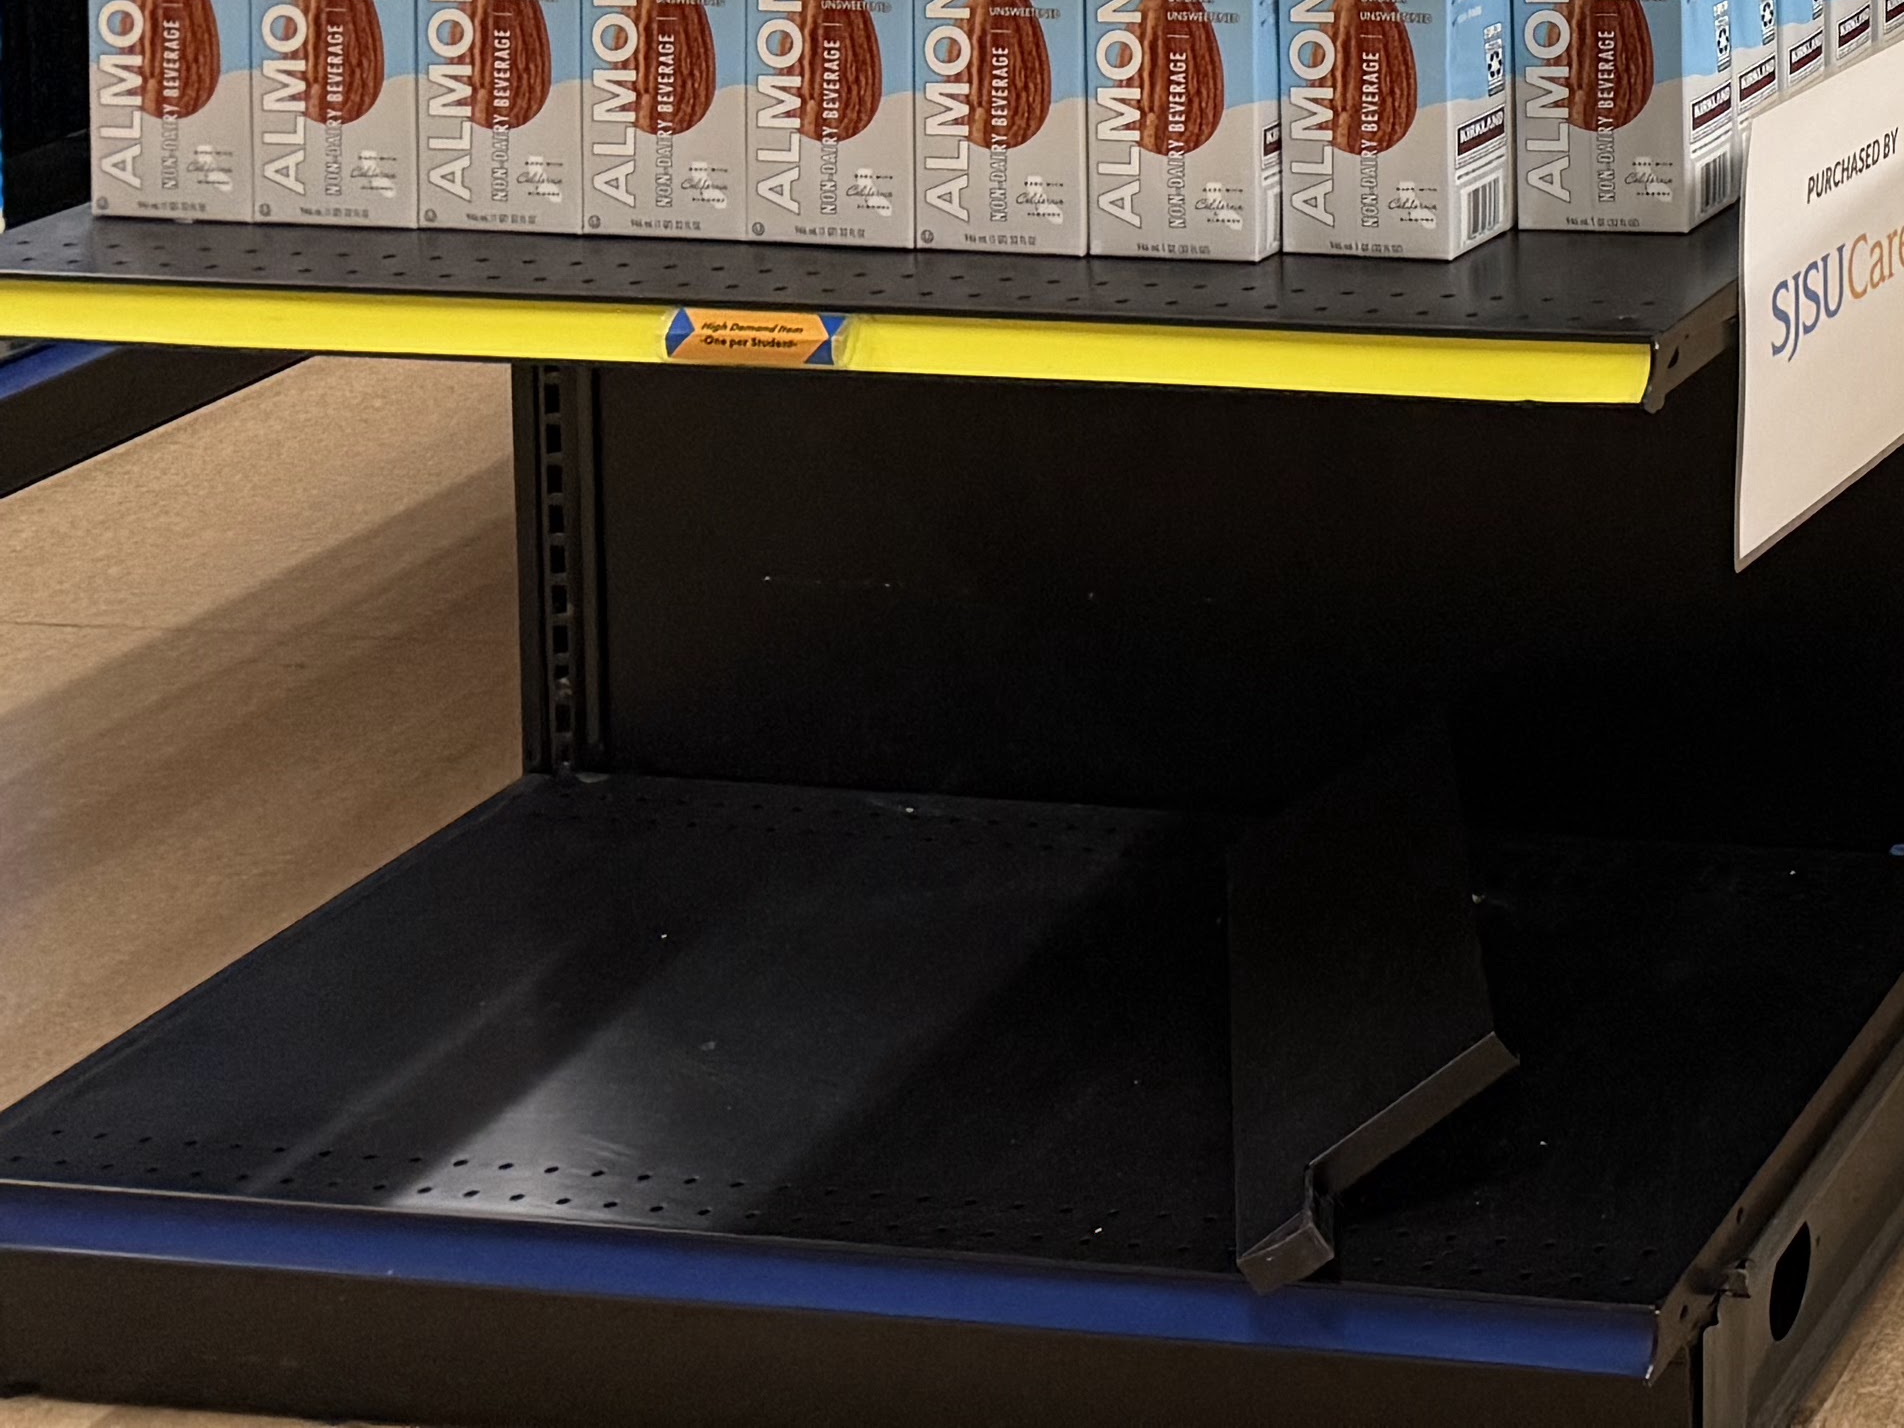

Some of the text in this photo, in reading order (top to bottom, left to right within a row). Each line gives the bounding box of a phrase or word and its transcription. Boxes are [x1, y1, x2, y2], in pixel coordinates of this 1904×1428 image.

[1168, 51, 1187, 133] BEVERAGE
[1806, 127, 1899, 205] PURCHASED BY
